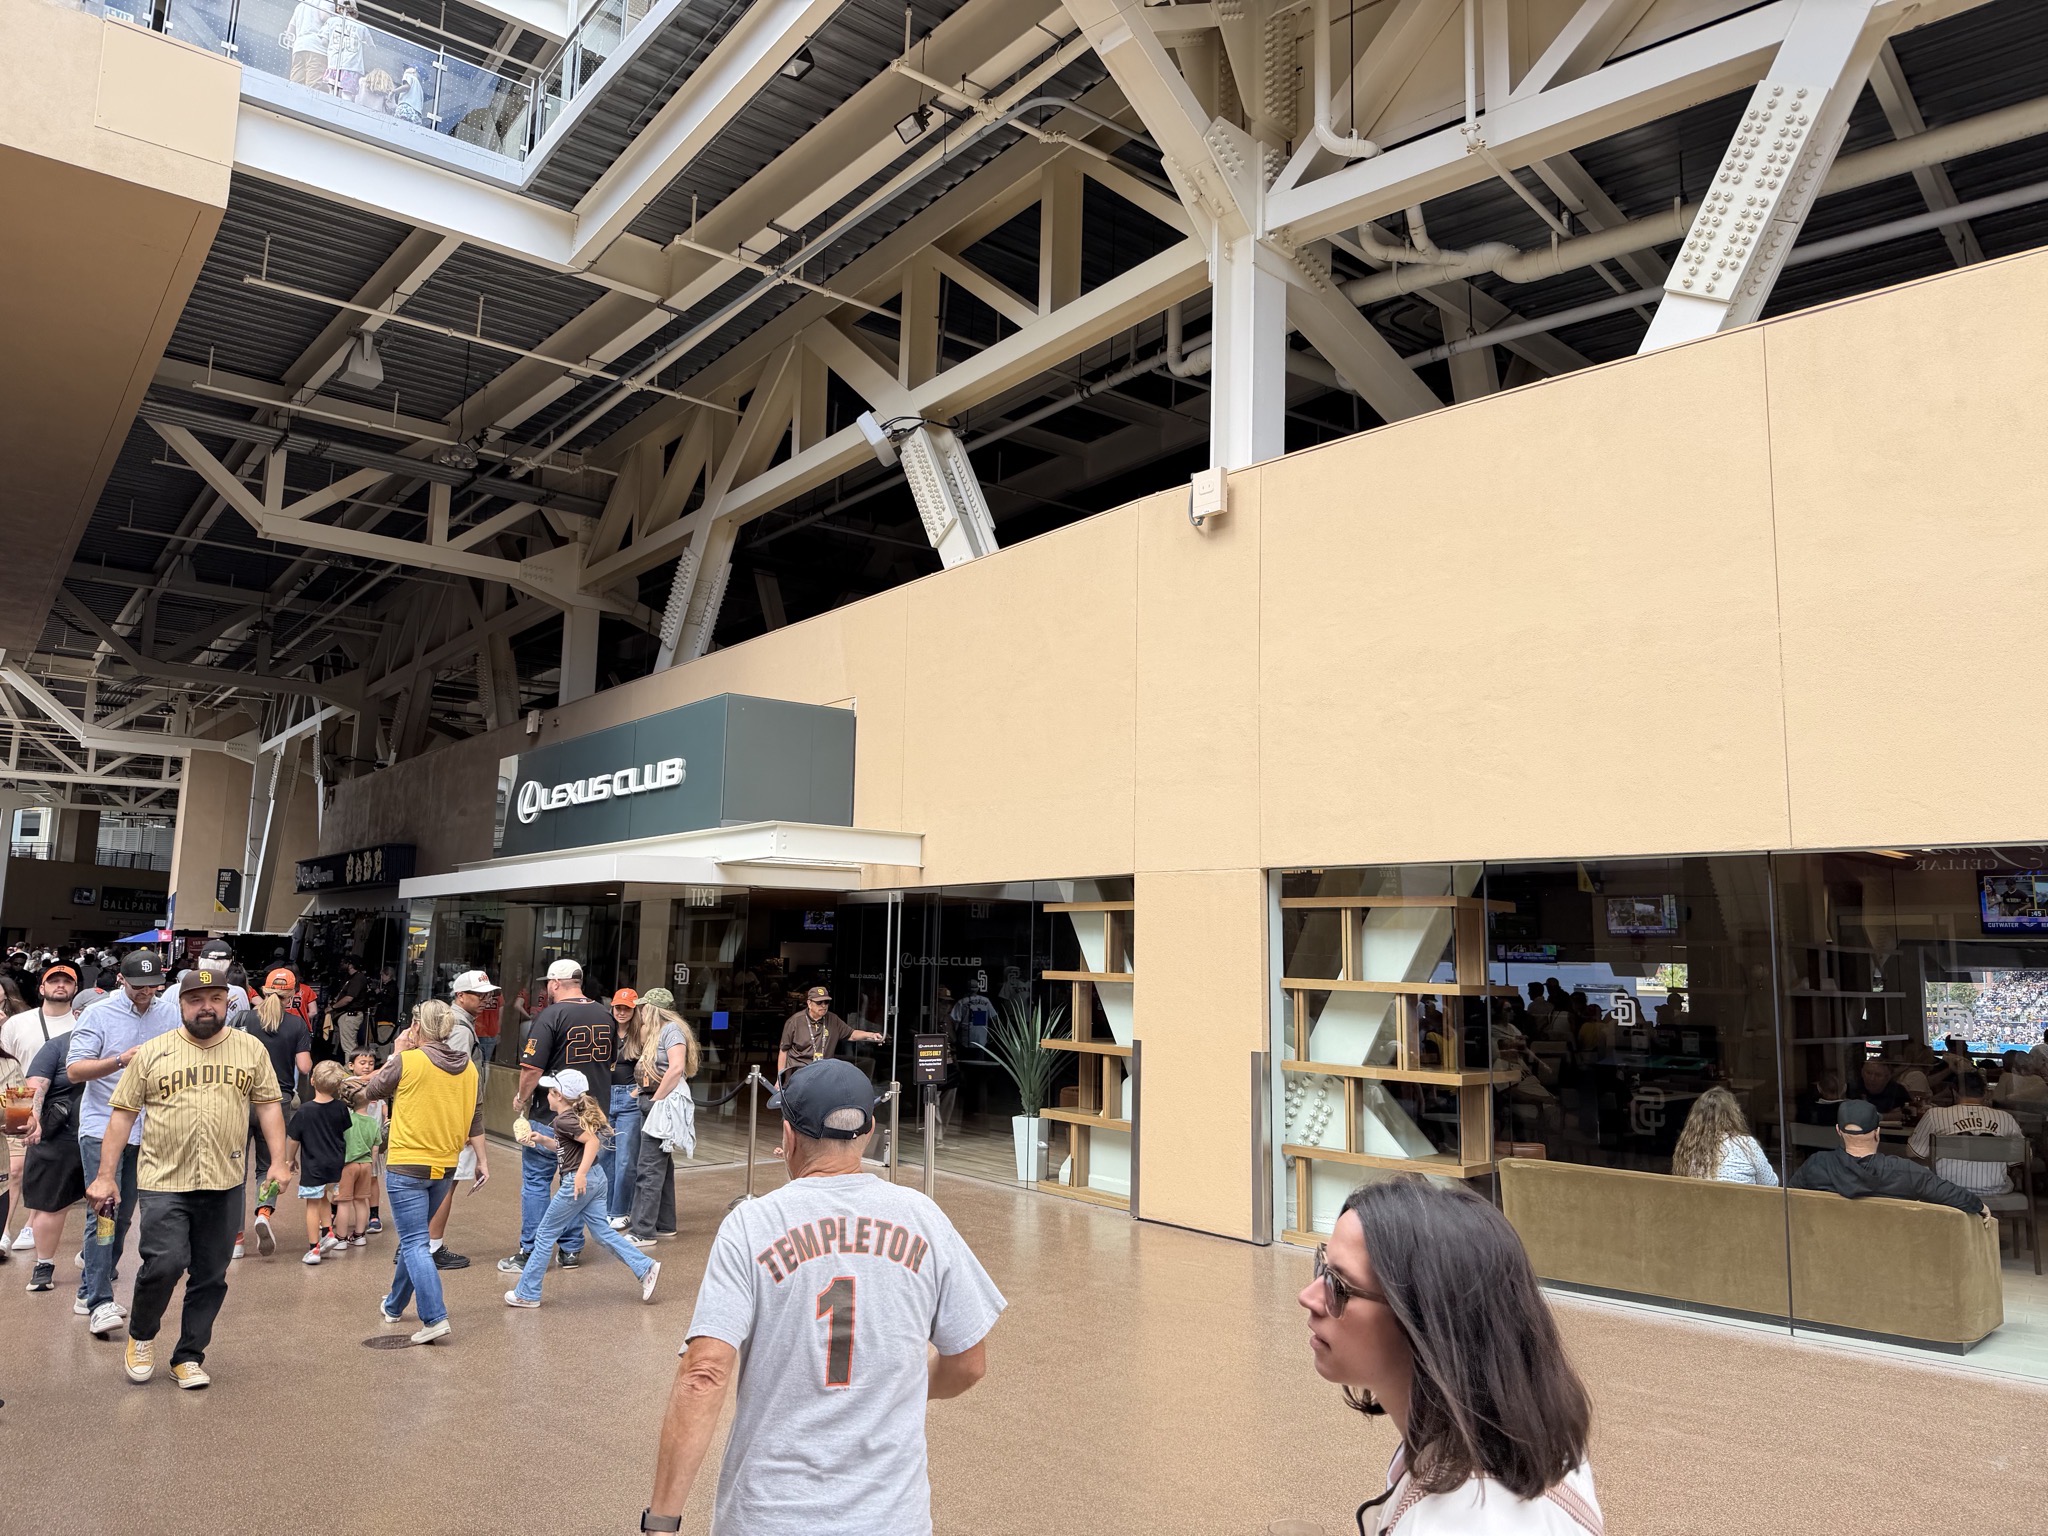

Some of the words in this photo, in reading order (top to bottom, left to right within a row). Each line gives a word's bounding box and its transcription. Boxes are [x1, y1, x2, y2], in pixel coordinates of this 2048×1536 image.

[541, 773, 613, 811] LEXUS
[613, 757, 687, 796] CLUB
[102, 899, 158, 912] BALLPARK
[913, 957, 949, 965] LEXUS
[950, 957, 982, 966] CLUB
[566, 1024, 612, 1064] 25
[158, 1066, 198, 1100] SAN
[202, 1064, 253, 1097] DIEGO
[1953, 1117, 1983, 1132] TATIS
[756, 1216, 929, 1284] TEMPLETON
[815, 1276, 856, 1387] 1
